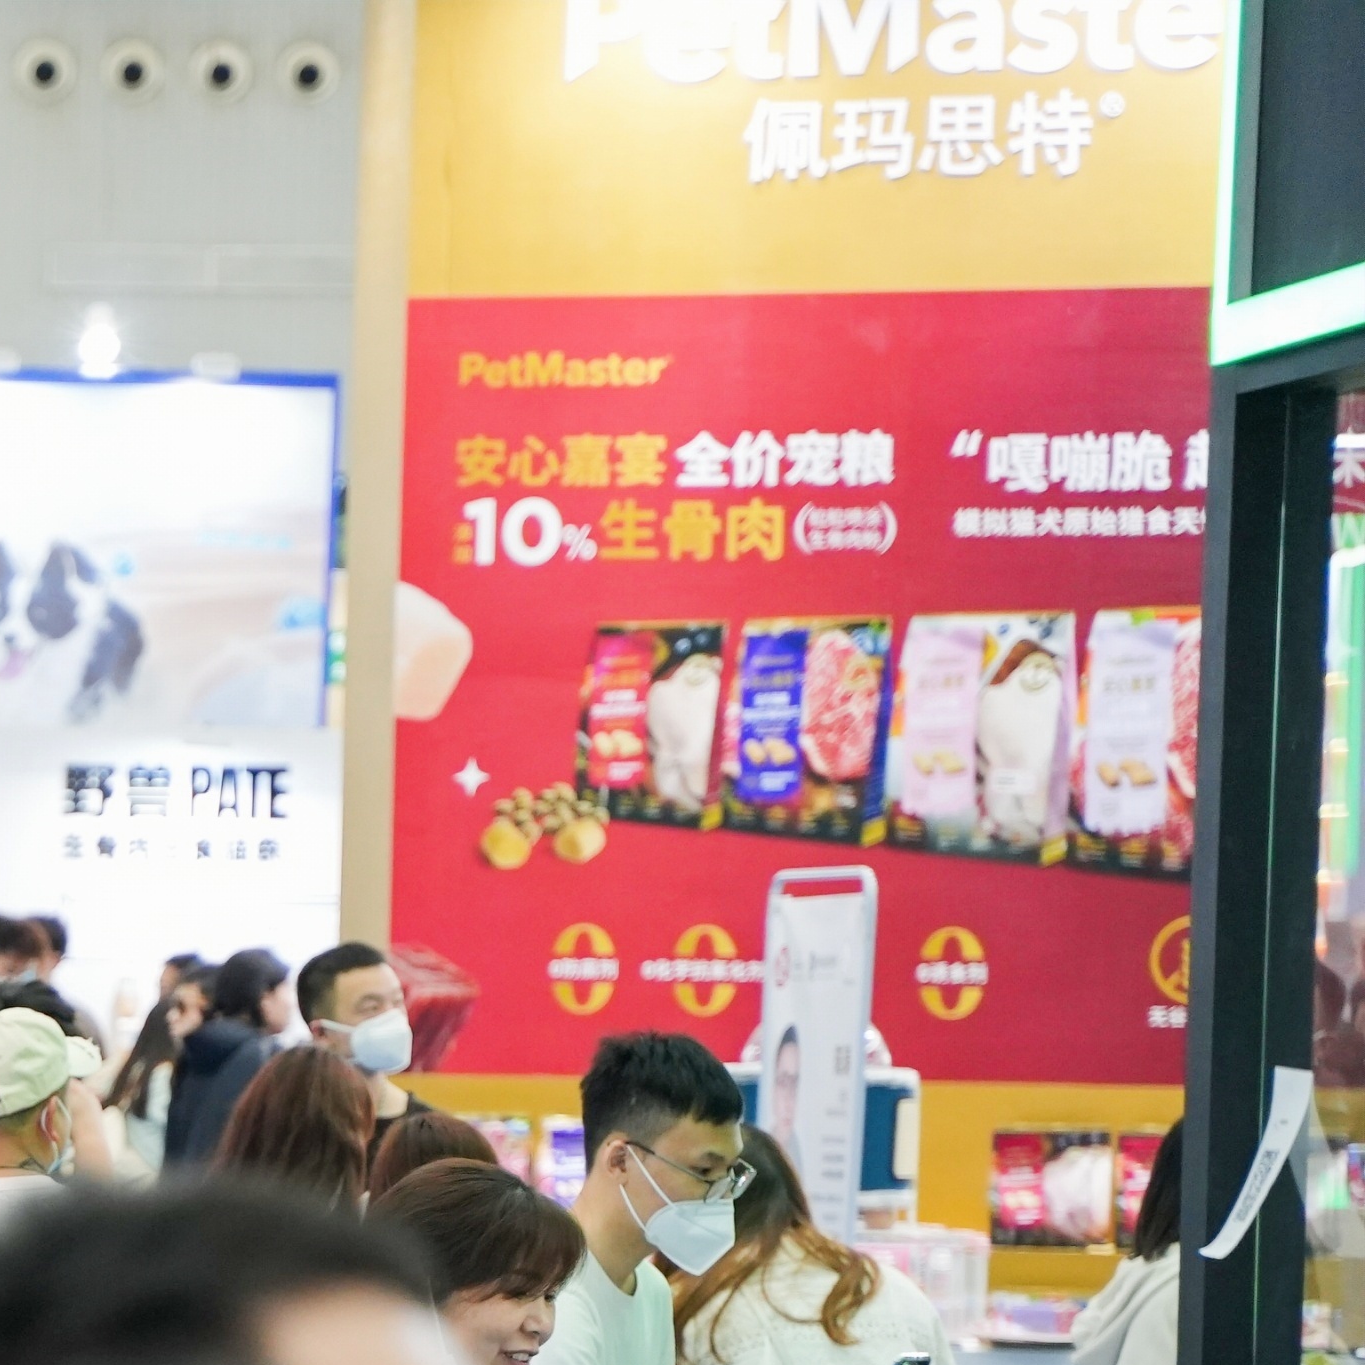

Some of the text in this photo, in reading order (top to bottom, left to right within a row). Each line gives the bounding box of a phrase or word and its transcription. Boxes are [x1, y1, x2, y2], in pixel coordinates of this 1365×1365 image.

[744, 90, 1094, 184] 佩玛思特
[458, 350, 669, 389] PetMaster
[455, 429, 896, 489] 安心嘉宴 全价宠粮
[952, 505, 1208, 538] 模拟猫犬原始猎食天
[62, 763, 289, 819] 野兽 PATE
